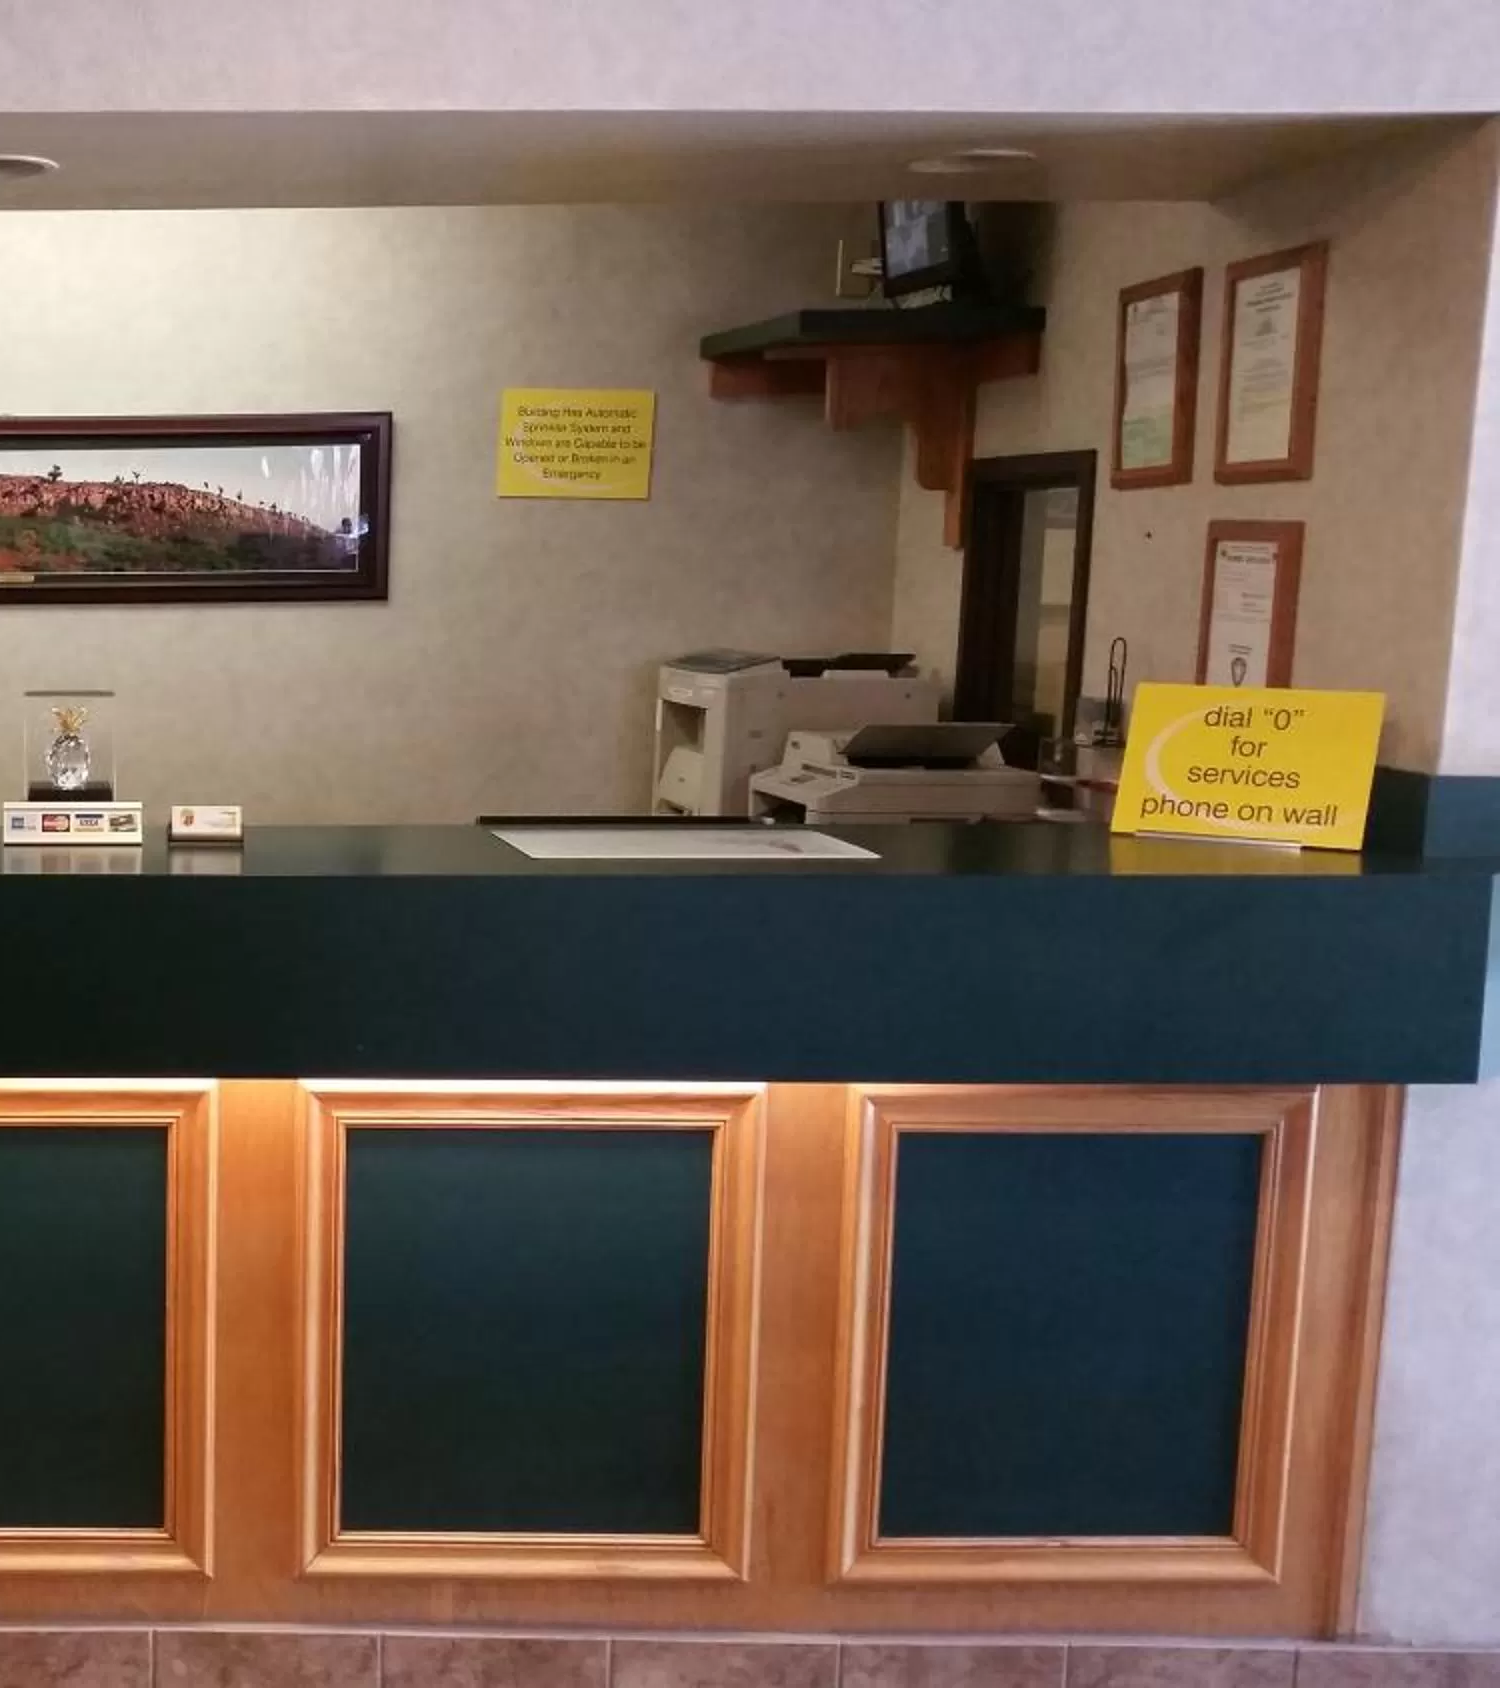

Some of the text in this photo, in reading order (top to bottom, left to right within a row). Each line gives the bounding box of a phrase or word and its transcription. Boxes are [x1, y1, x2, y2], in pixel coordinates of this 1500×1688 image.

[518, 405, 637, 419] Building Has Automatic
[523, 421, 631, 434] Sprinkler System and
[505, 435, 646, 450] Windows are Capable to be
[513, 452, 555, 464] Opened
[557, 455, 569, 463] or
[571, 453, 608, 464] Broken
[610, 454, 619, 463] in
[542, 468, 602, 480] Emergency
[1204, 706, 1253, 728] dial
[1230, 736, 1267, 758] for
[1187, 765, 1300, 788] services
[1140, 795, 1339, 826] phone on wall
